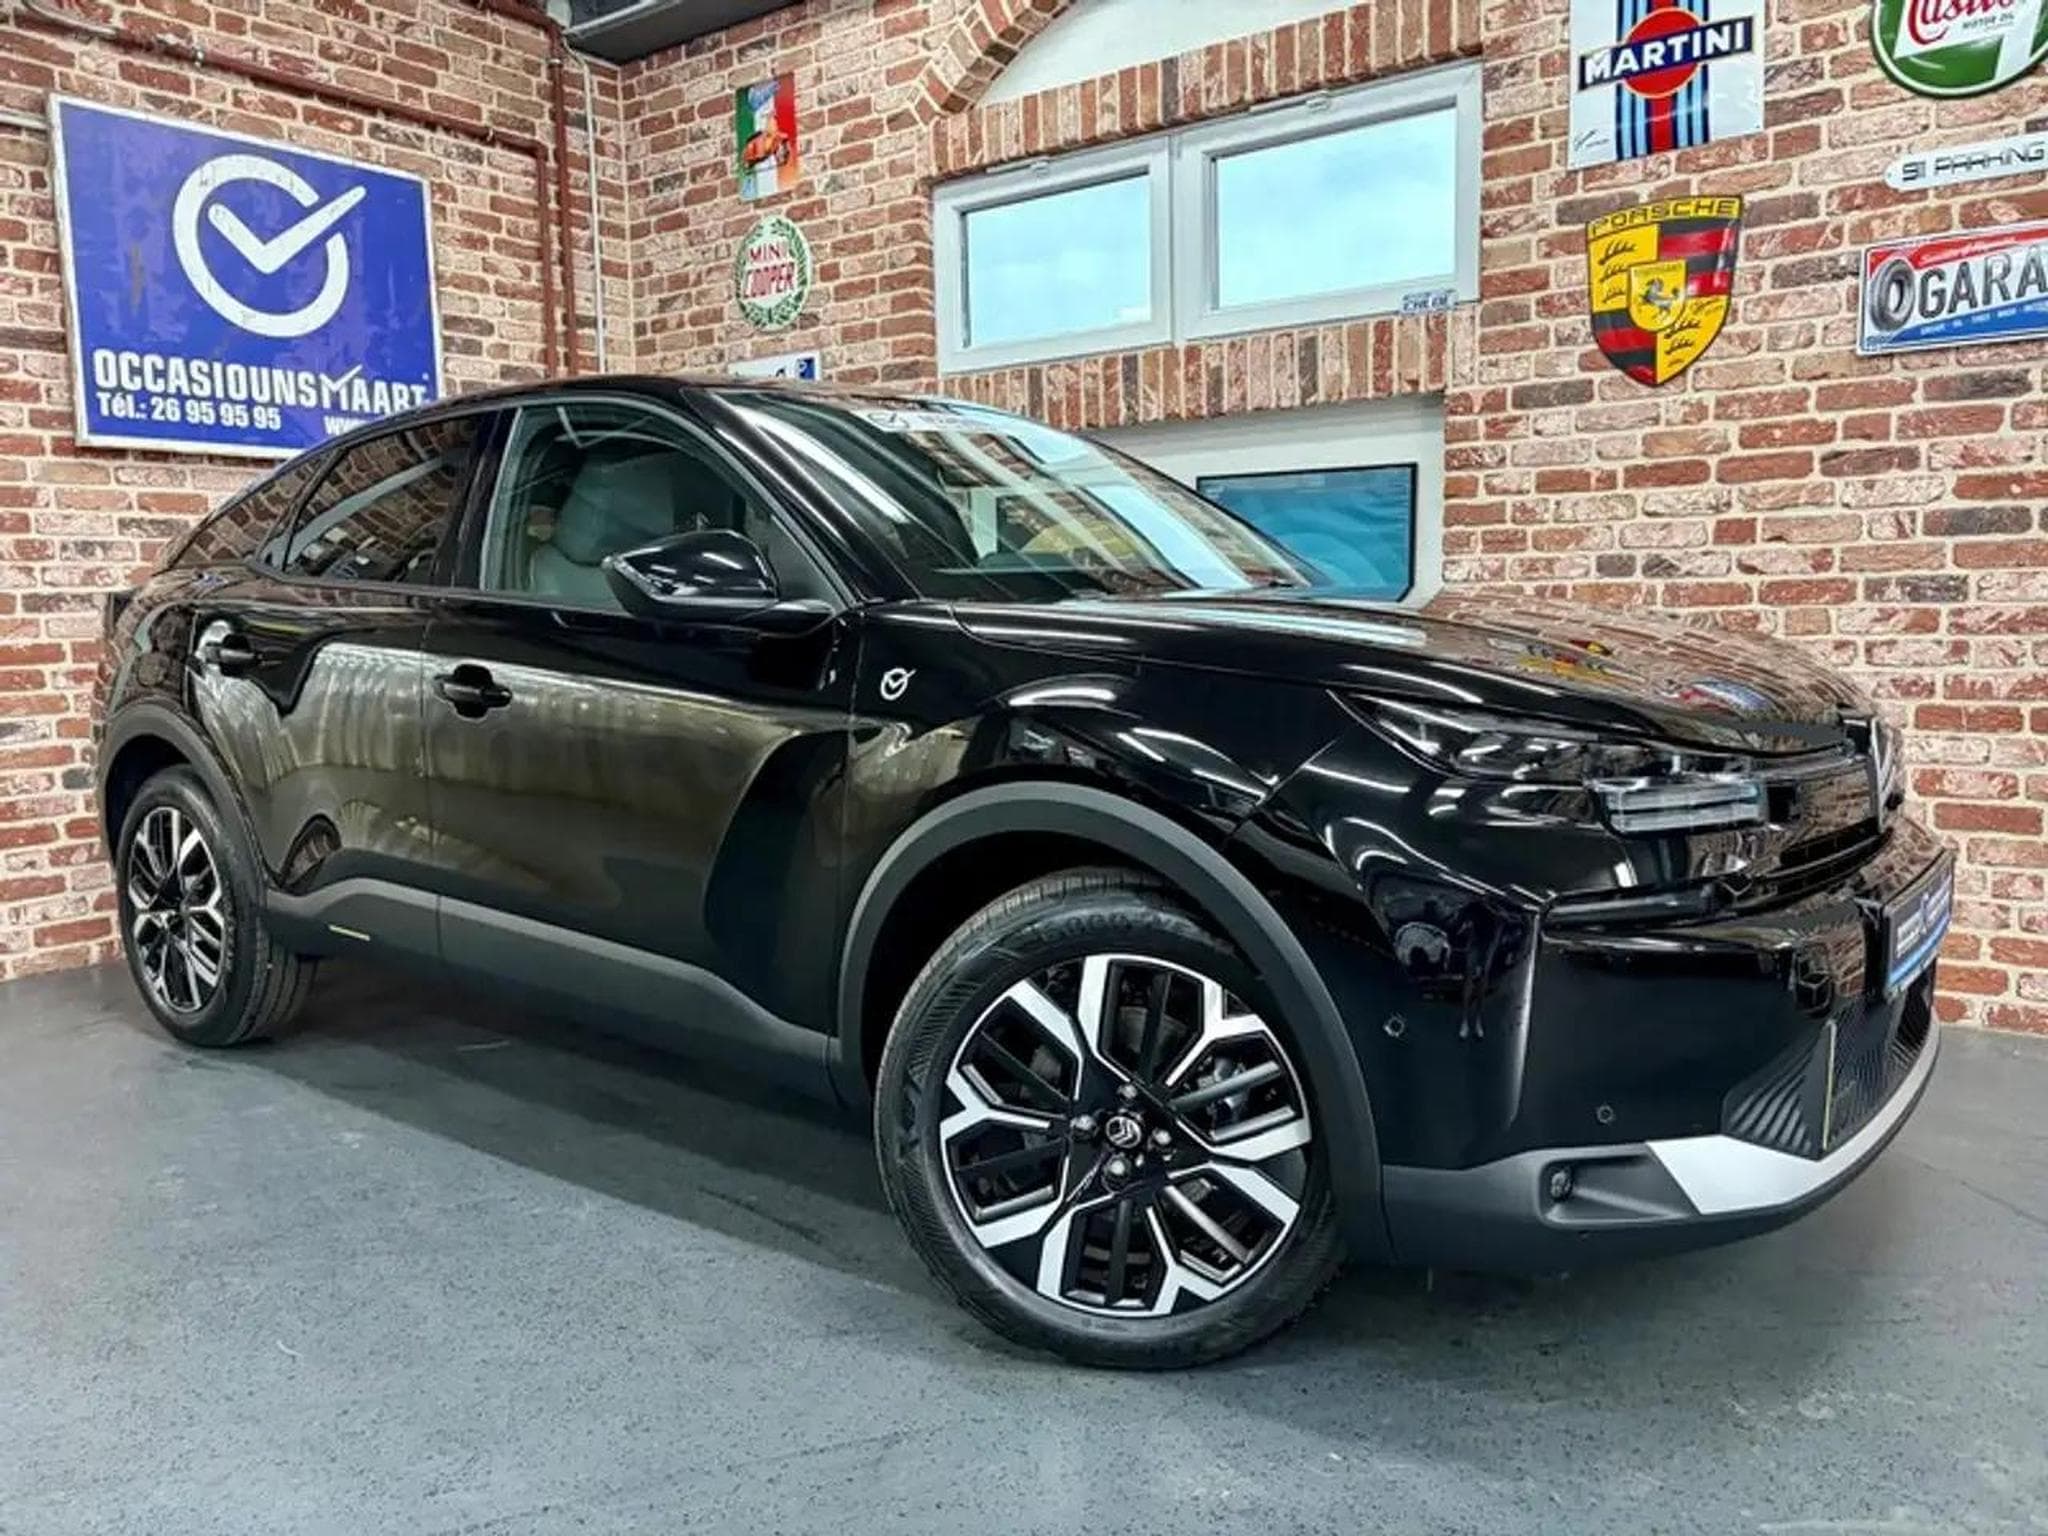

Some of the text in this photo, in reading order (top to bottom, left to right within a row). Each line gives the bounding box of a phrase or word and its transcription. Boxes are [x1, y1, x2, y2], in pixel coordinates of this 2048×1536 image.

[1584, 21, 1745, 84] MARTINI
[1934, 141, 2045, 175] PARKING
[1592, 200, 1736, 234] PORSCHE
[750, 243, 789, 261] MINI
[744, 262, 795, 298] COOPER
[151, 396, 181, 422] 26
[185, 399, 216, 425] 95
[219, 402, 249, 428] 95
[253, 405, 282, 430] 95
